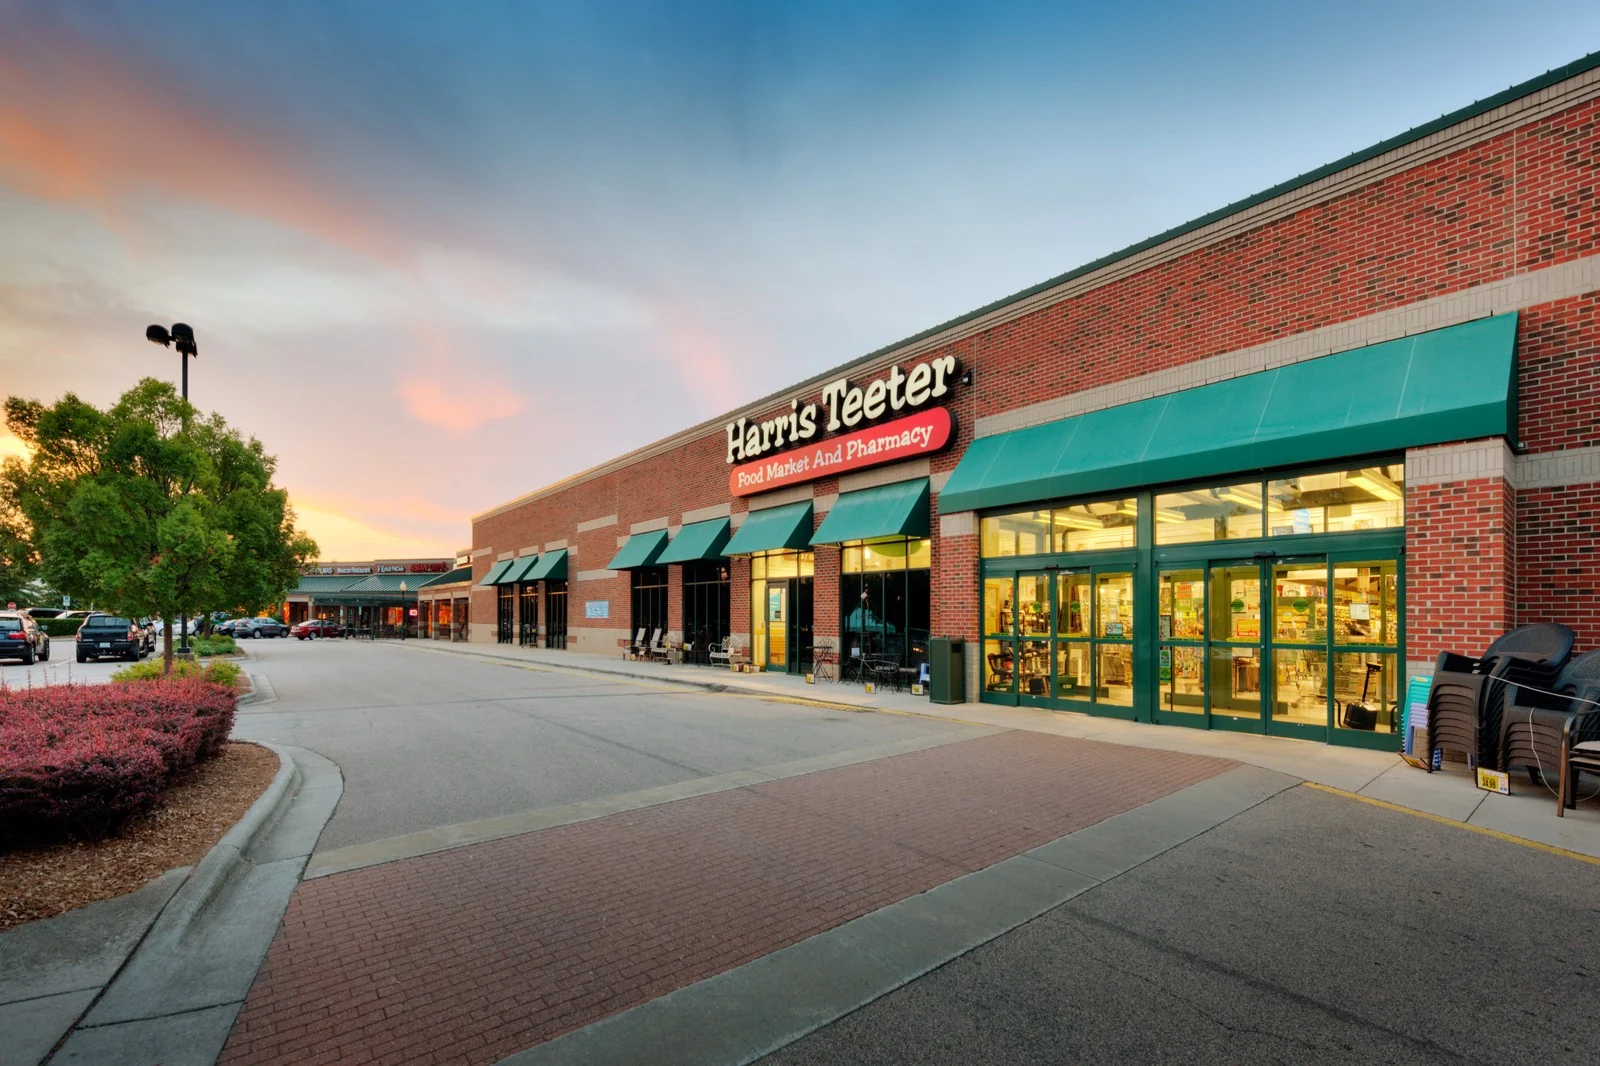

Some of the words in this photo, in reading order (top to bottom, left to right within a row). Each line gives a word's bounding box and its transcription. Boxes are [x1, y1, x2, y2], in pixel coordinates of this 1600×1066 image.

[726, 400, 817, 464] Harris
[822, 355, 956, 432] Teeter
[737, 467, 764, 488] Food
[766, 455, 810, 481] Market
[812, 445, 843, 469] And
[846, 425, 934, 460] Pharmacy
